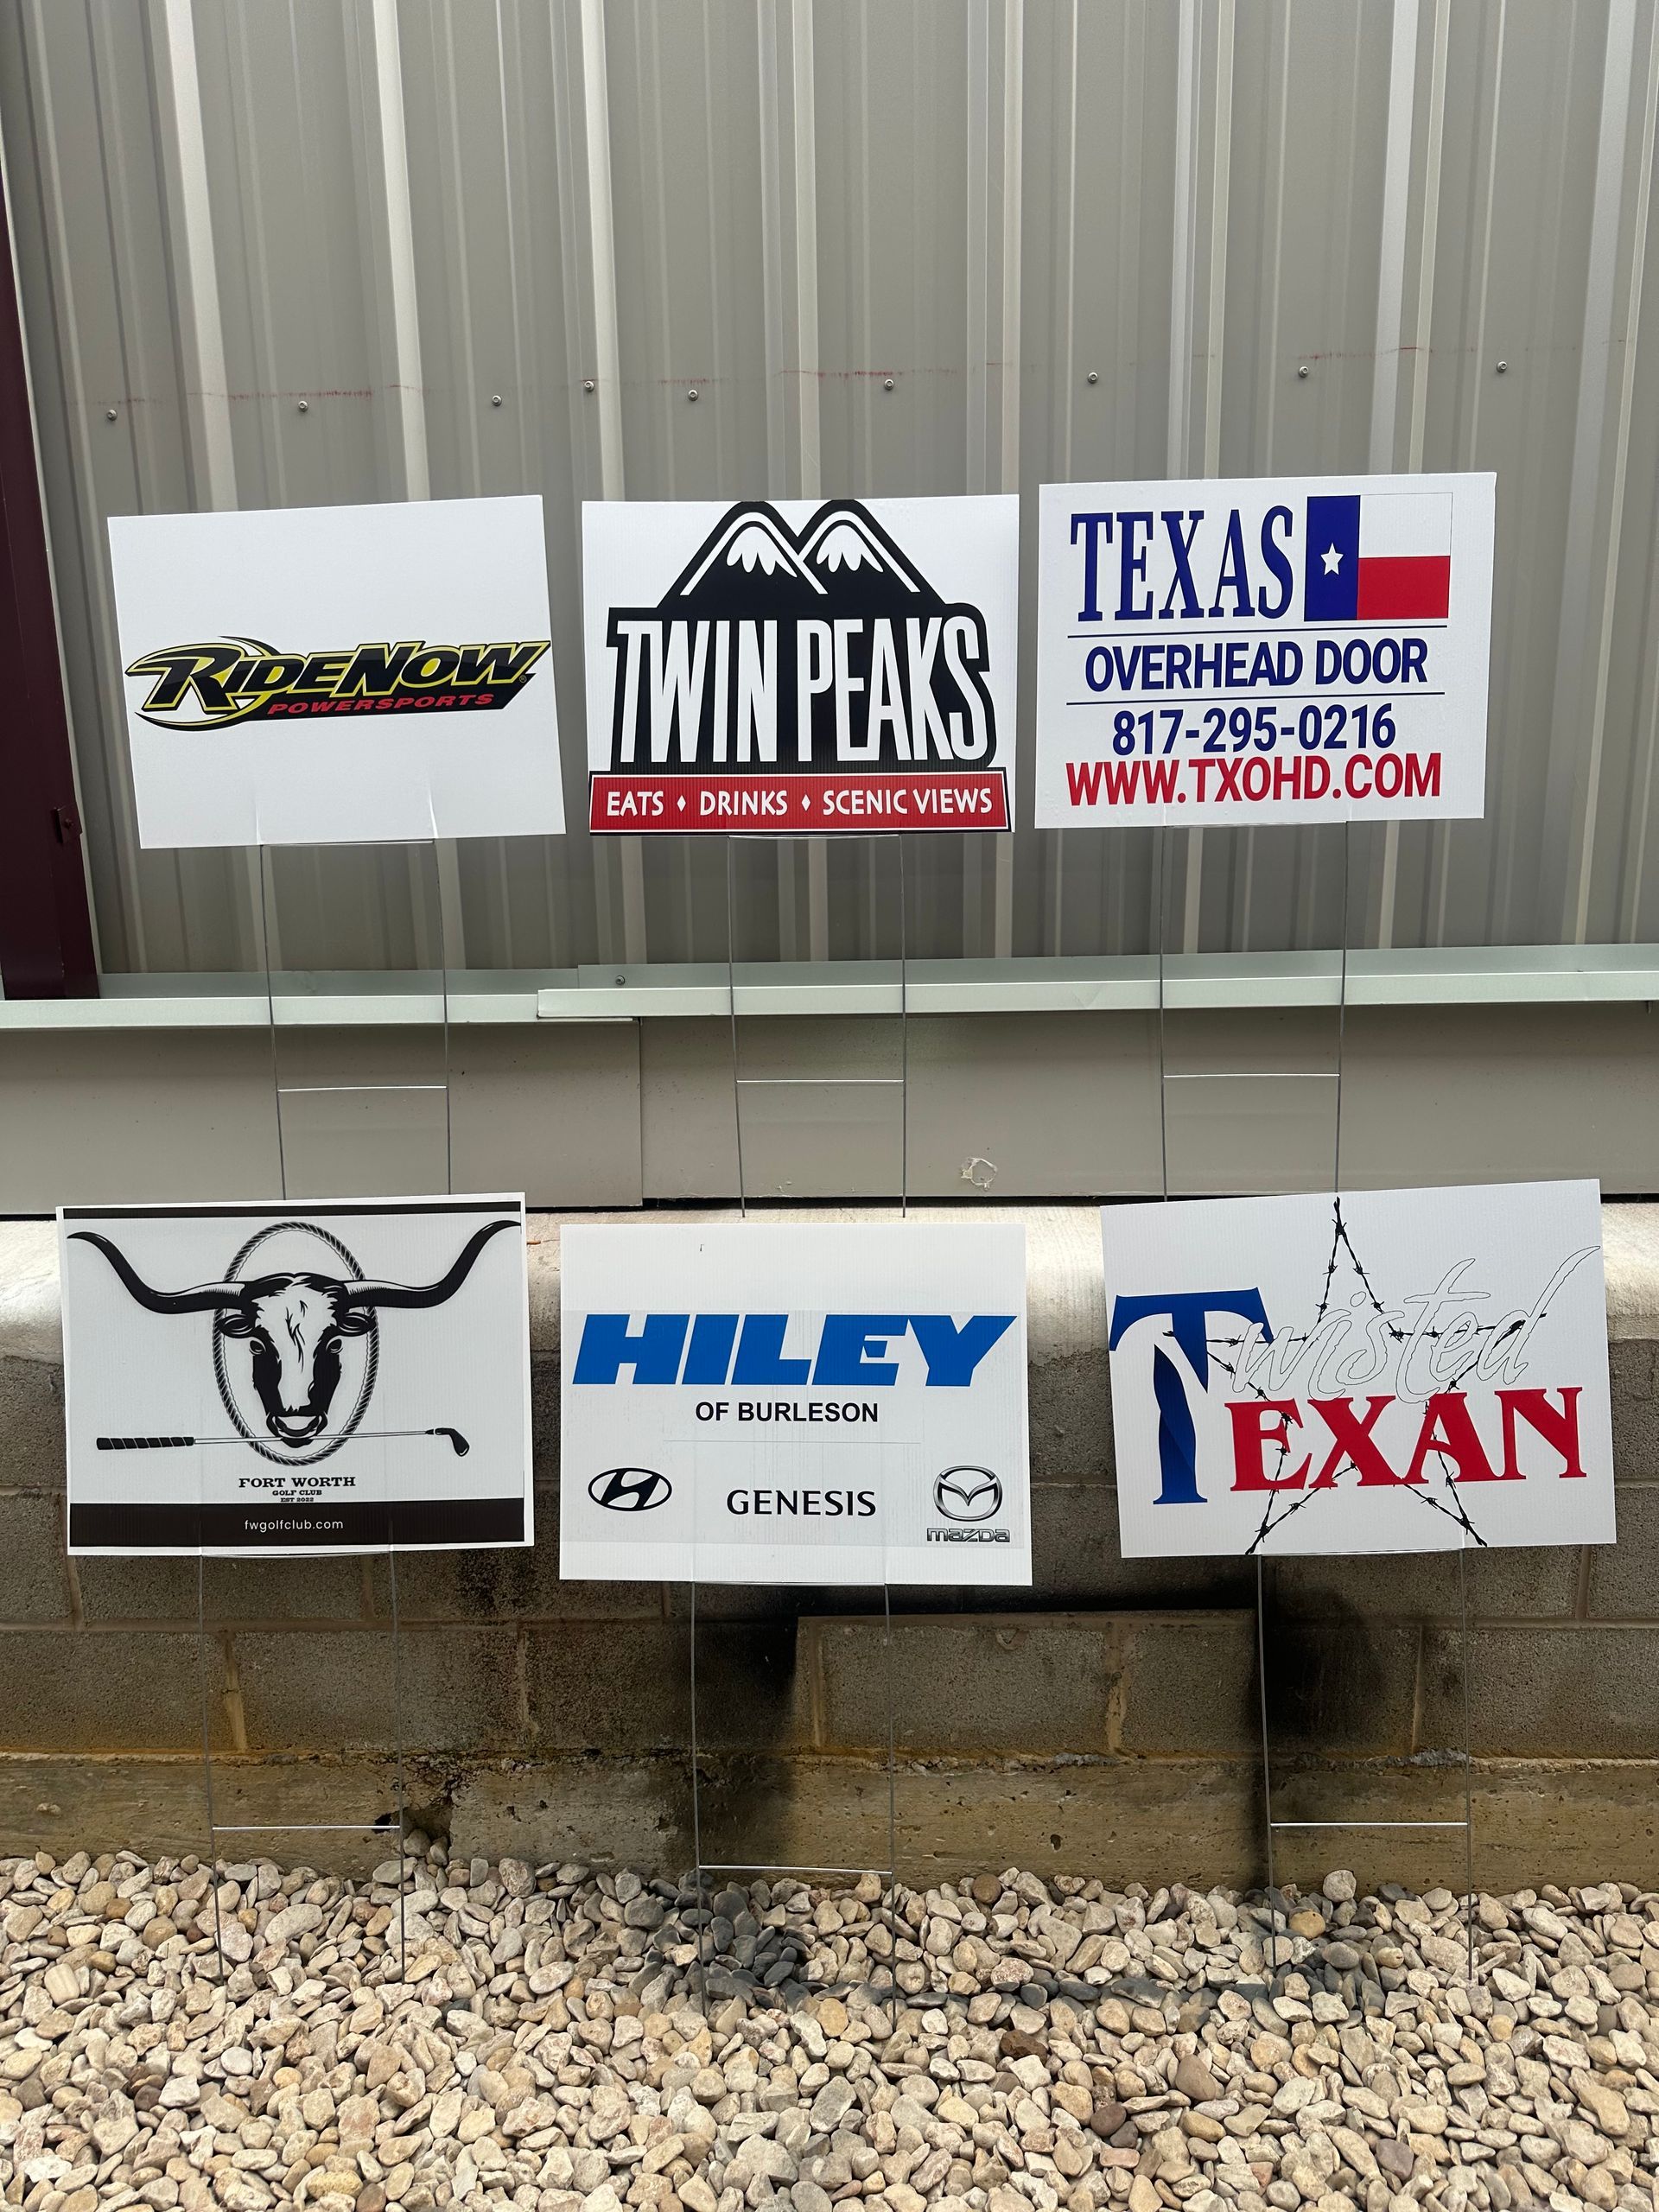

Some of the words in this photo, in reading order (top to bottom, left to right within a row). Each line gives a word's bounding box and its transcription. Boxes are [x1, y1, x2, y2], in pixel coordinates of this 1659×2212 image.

[1071, 505, 1294, 622] TEXAS
[1085, 641, 1303, 692] OVERHEAD
[1315, 638, 1428, 685] DOOR
[267, 693, 494, 715] POWERSPORTS
[617, 620, 777, 762] TWIN
[797, 615, 988, 761] PEAKS
[1112, 702, 1396, 756] 817-295-0216
[1065, 753, 1441, 806] WWW.TXOHD.COM
[607, 791, 664, 817] EATS
[700, 790, 788, 816] DRINKS
[823, 789, 907, 815] SCENIC
[912, 788, 993, 813] VIEWS
[572, 1313, 1018, 1387] HILEY
[696, 1402, 730, 1421] OF
[738, 1402, 879, 1422] BURLESON
[238, 1478, 286, 1488] FORT
[291, 1477, 356, 1487] WORTH
[726, 1490, 877, 1516] GENESIS
[245, 1519, 344, 1533] fwgolfclub.com
